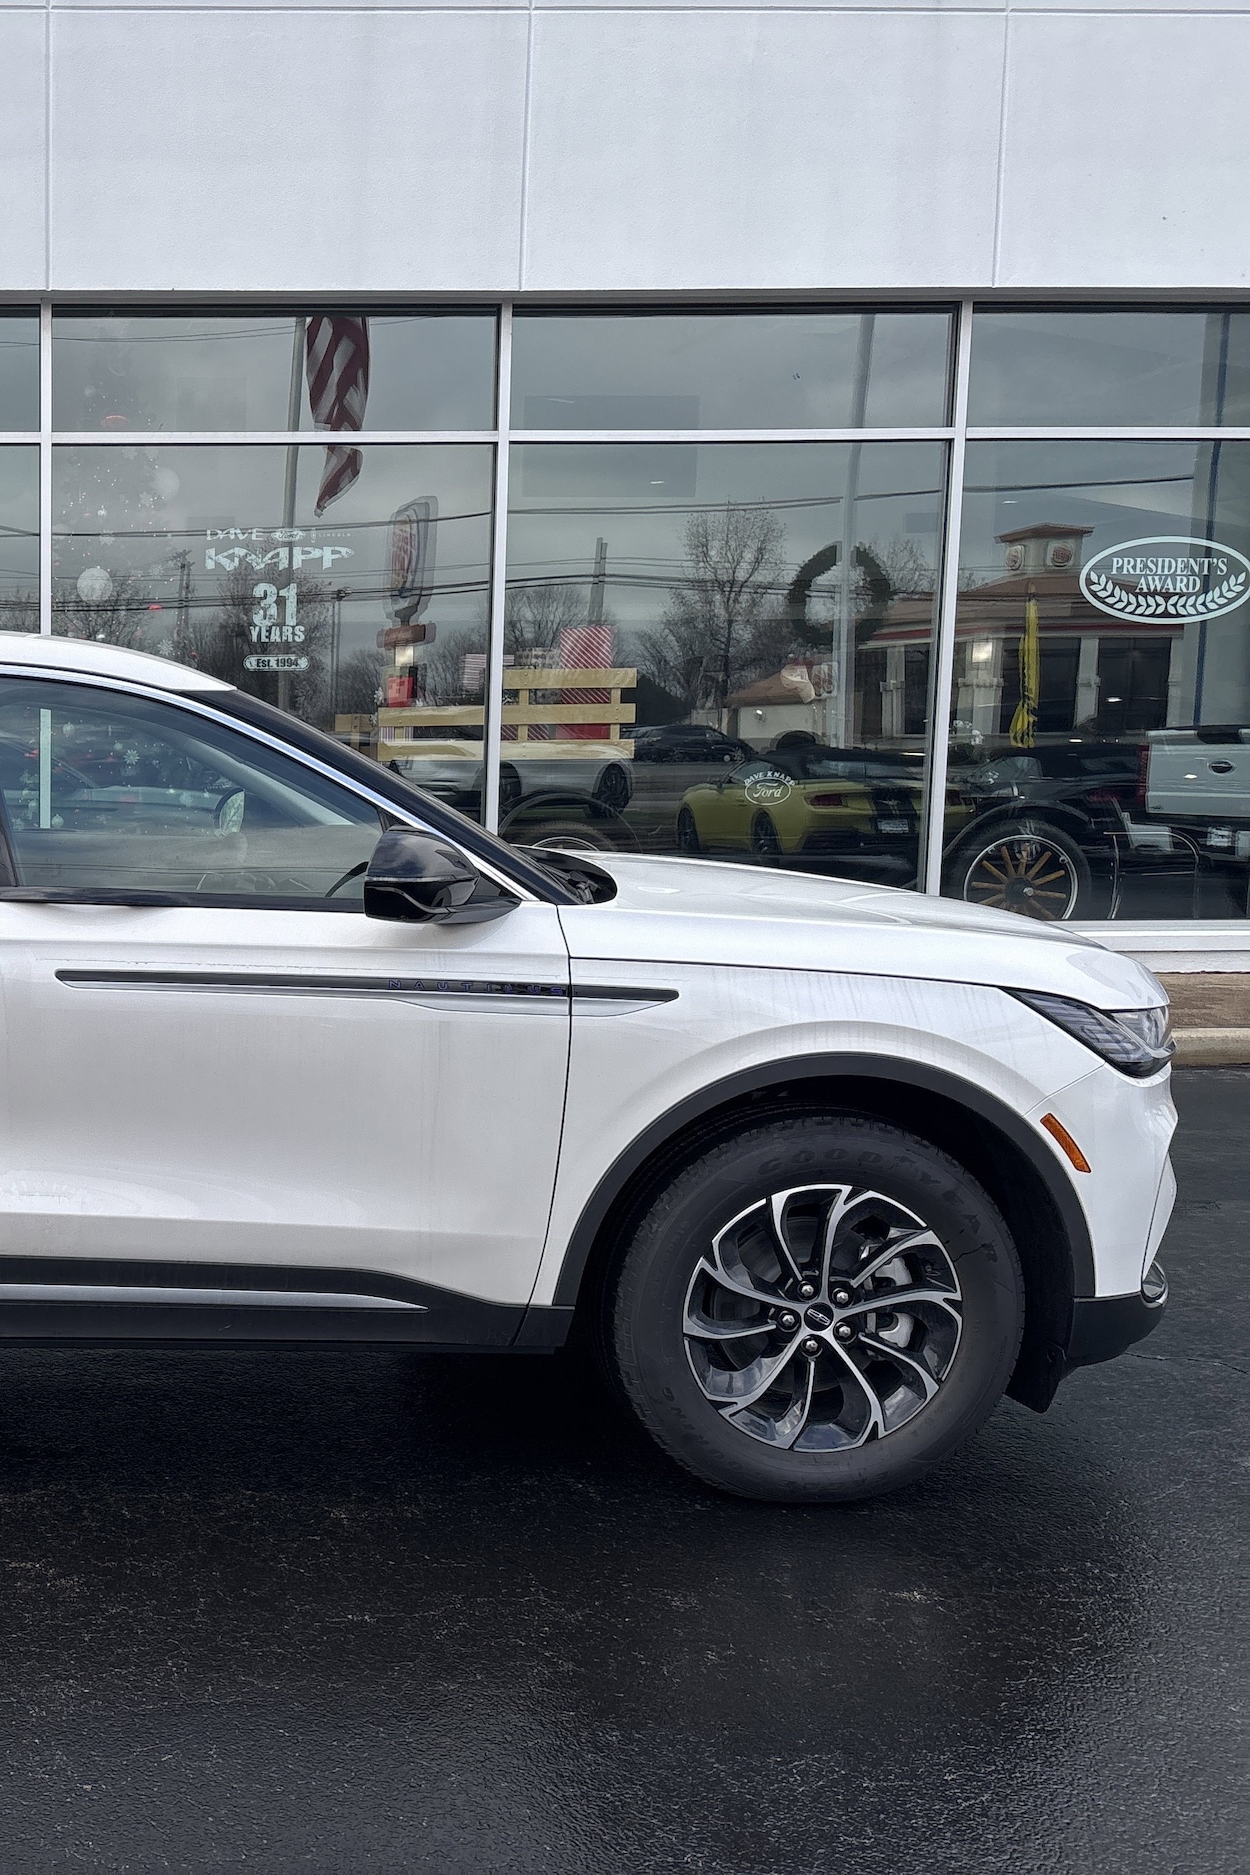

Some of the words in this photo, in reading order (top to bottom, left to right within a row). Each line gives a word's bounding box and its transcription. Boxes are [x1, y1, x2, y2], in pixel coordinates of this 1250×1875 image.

[206, 528, 264, 541] DAVE
[205, 547, 354, 571] KNAPP
[1110, 557, 1228, 575] PRESIDENT'S
[1135, 576, 1201, 593] AWARD
[253, 583, 298, 626] 31
[250, 625, 305, 643] YEARS
[256, 658, 273, 668] Est.
[276, 658, 299, 668] 1994
[744, 771, 765, 786] DAVE
[753, 782, 784, 798] Ford
[388, 979, 563, 996] NAUTILUS
